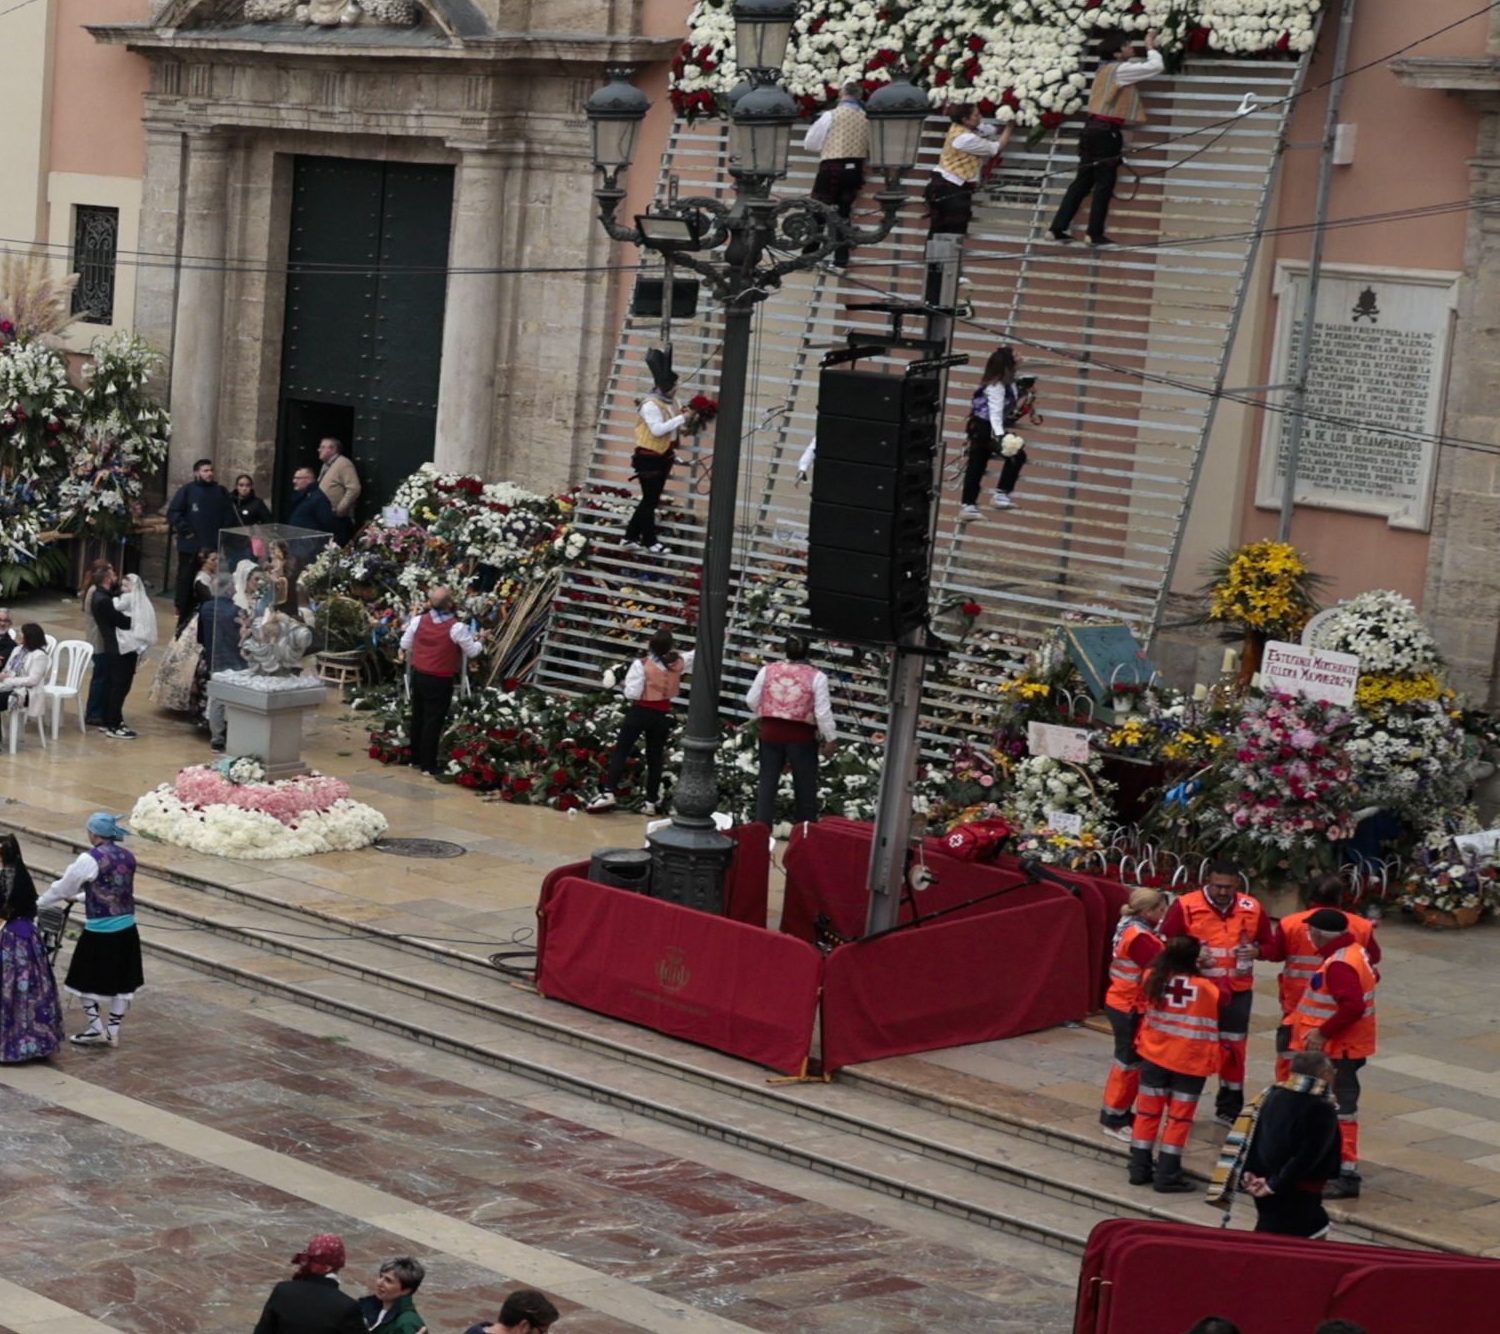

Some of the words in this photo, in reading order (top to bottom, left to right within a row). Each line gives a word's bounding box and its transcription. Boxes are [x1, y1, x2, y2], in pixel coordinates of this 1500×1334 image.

[1314, 430, 1325, 441] DE
[1330, 432, 1346, 443] LOS
[1351, 434, 1422, 452] DESAMPARADOS
